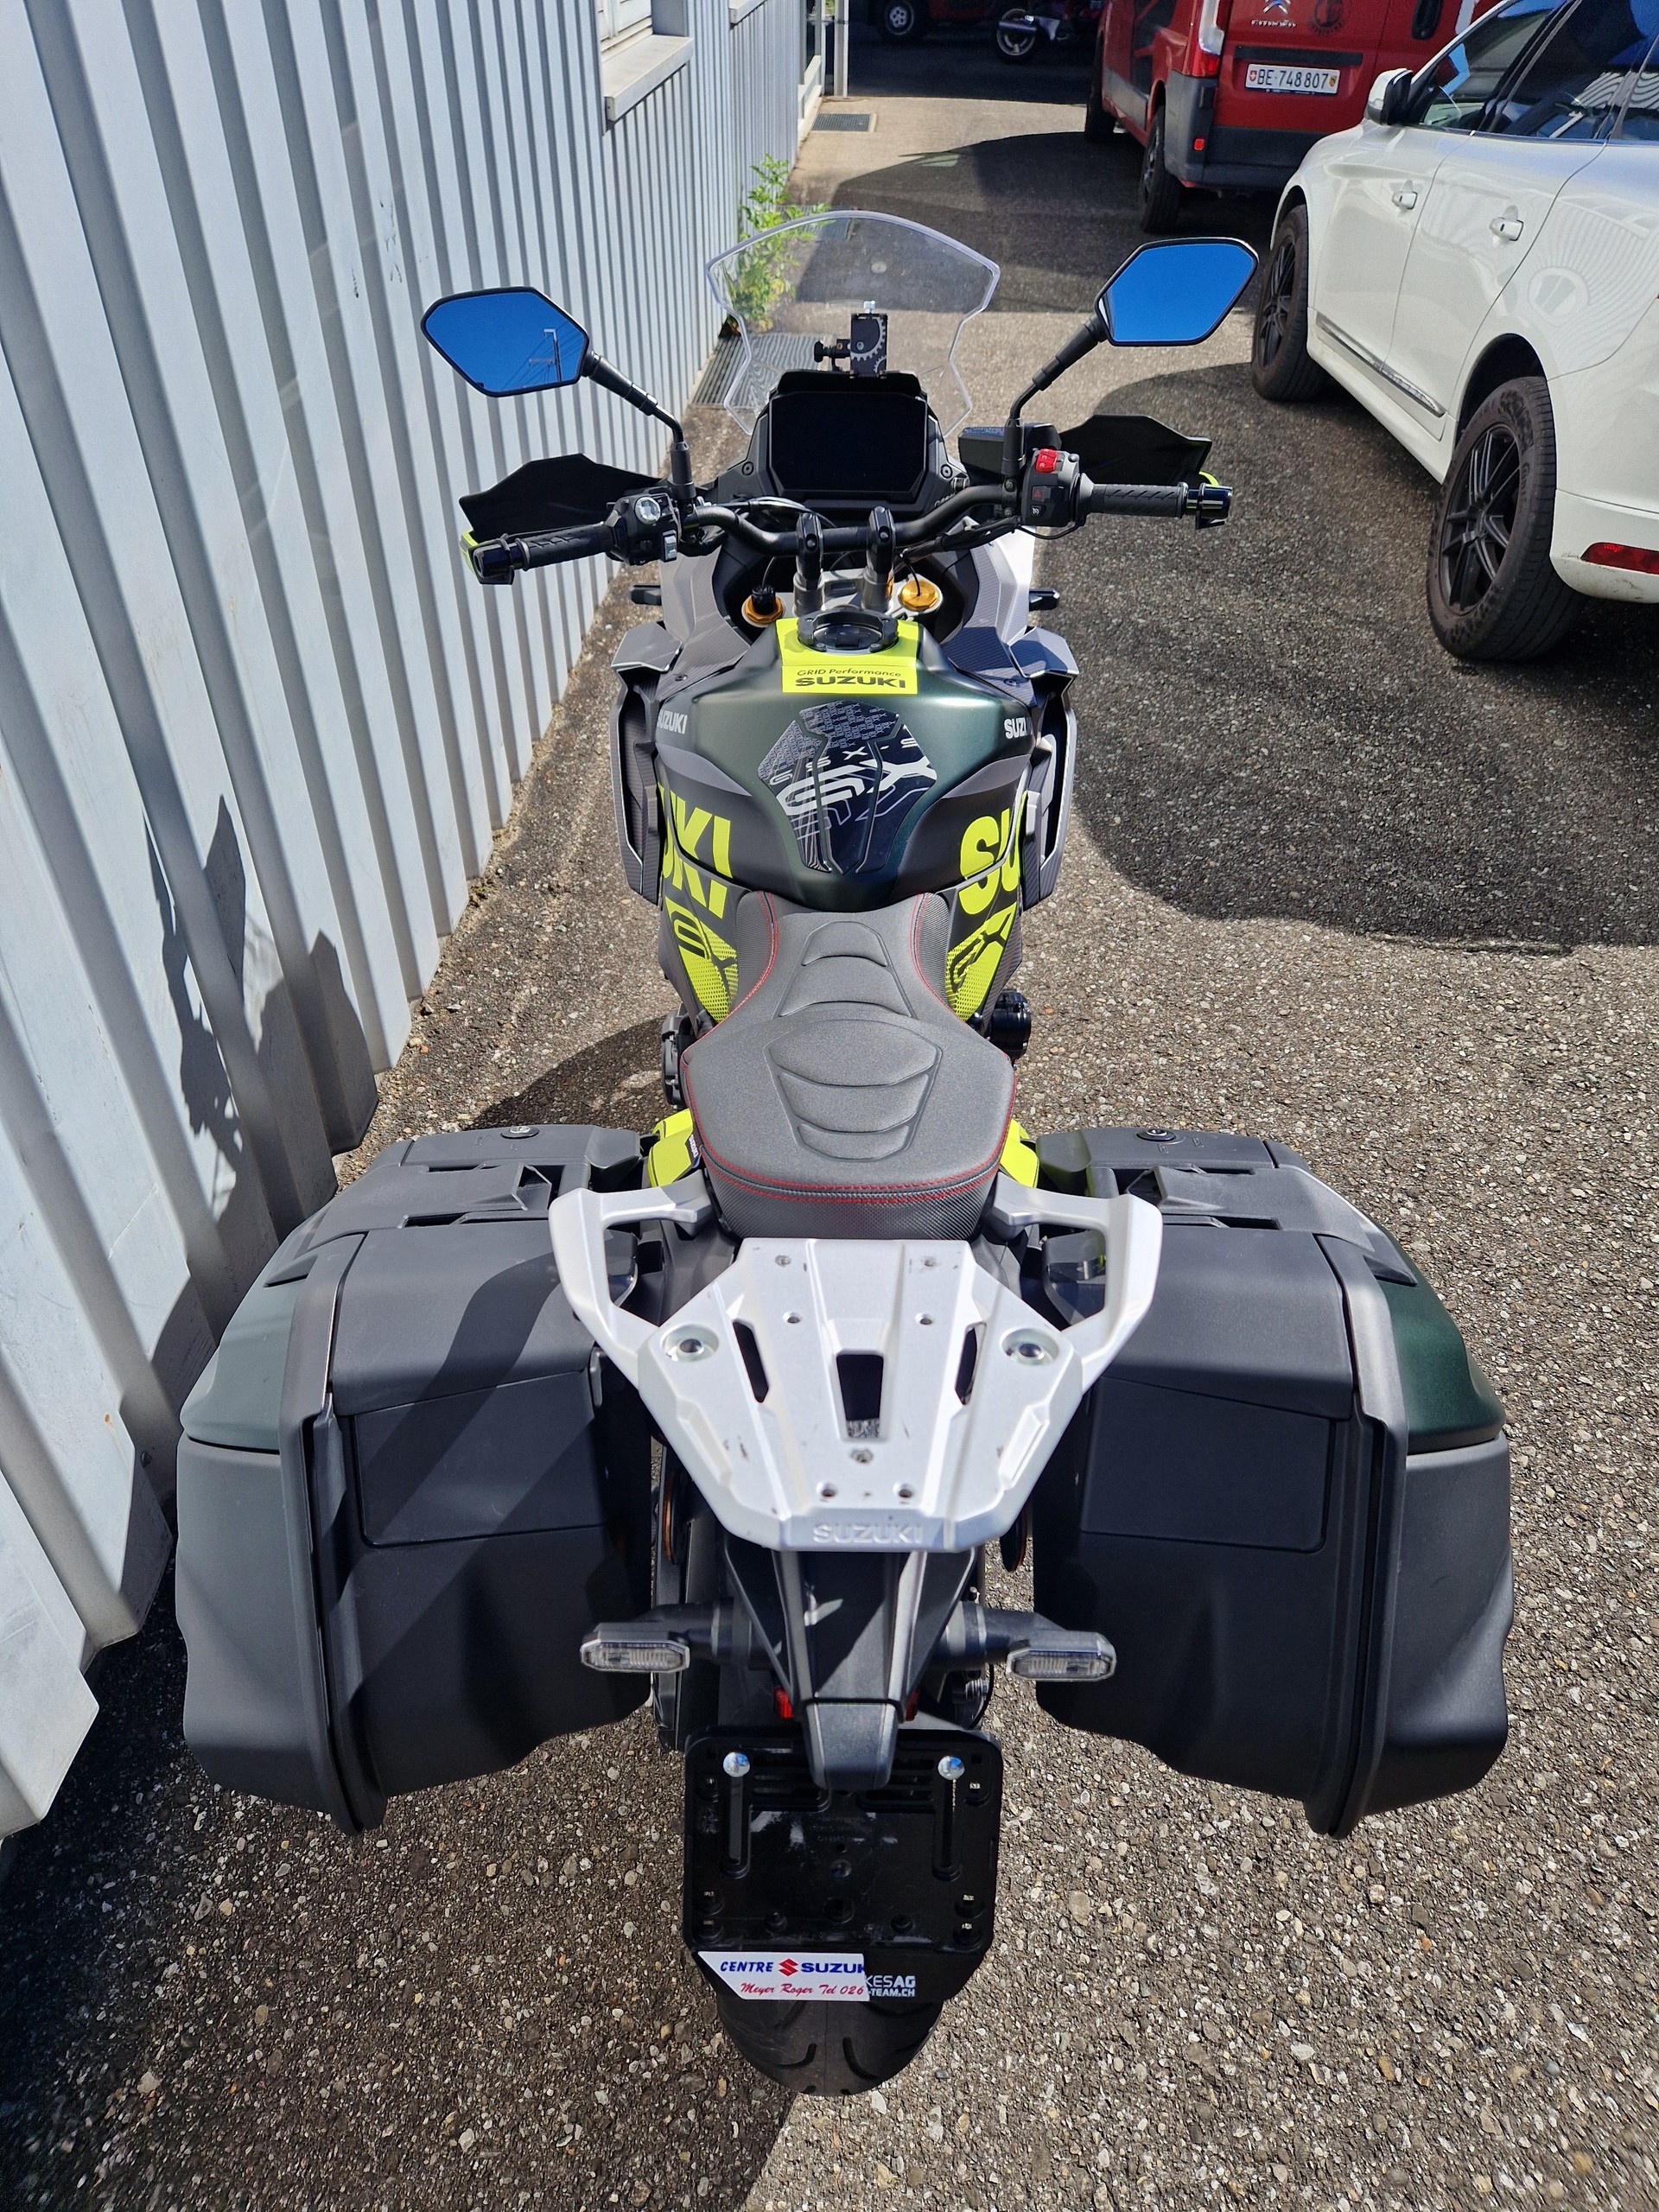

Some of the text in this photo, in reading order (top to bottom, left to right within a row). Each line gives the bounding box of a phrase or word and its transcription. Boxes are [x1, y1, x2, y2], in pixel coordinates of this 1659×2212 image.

[829, 667, 902, 677] Performance
[795, 676, 906, 689] SUZUKI
[812, 1523, 924, 1544] SUZUKI
[720, 1961, 774, 1974] CENTRE
[741, 1982, 864, 1996] Meyer Roger Tel 026
